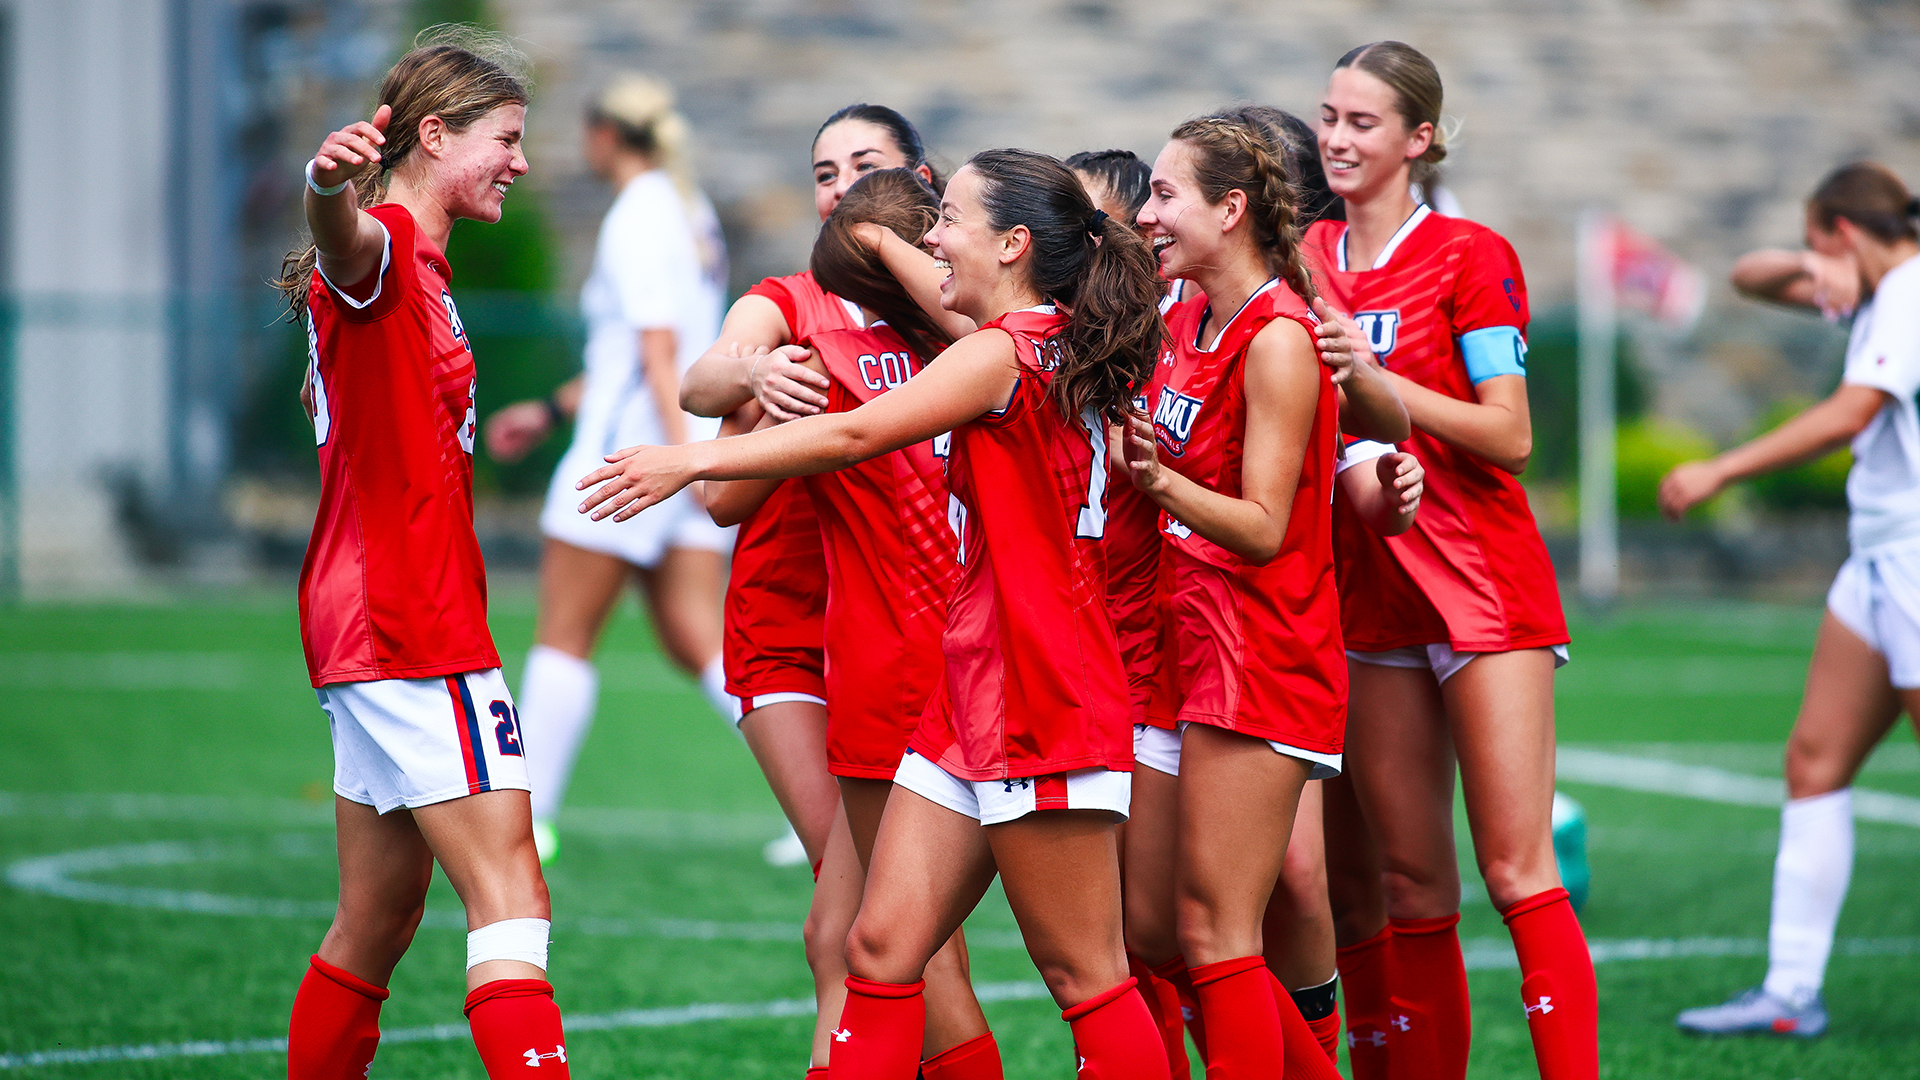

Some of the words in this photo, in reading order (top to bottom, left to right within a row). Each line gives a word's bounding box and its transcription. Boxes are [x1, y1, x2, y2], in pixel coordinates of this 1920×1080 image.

[1153, 386, 1204, 441] RMU
[1155, 426, 1181, 452] OLONIALS
[489, 700, 526, 760] 2
